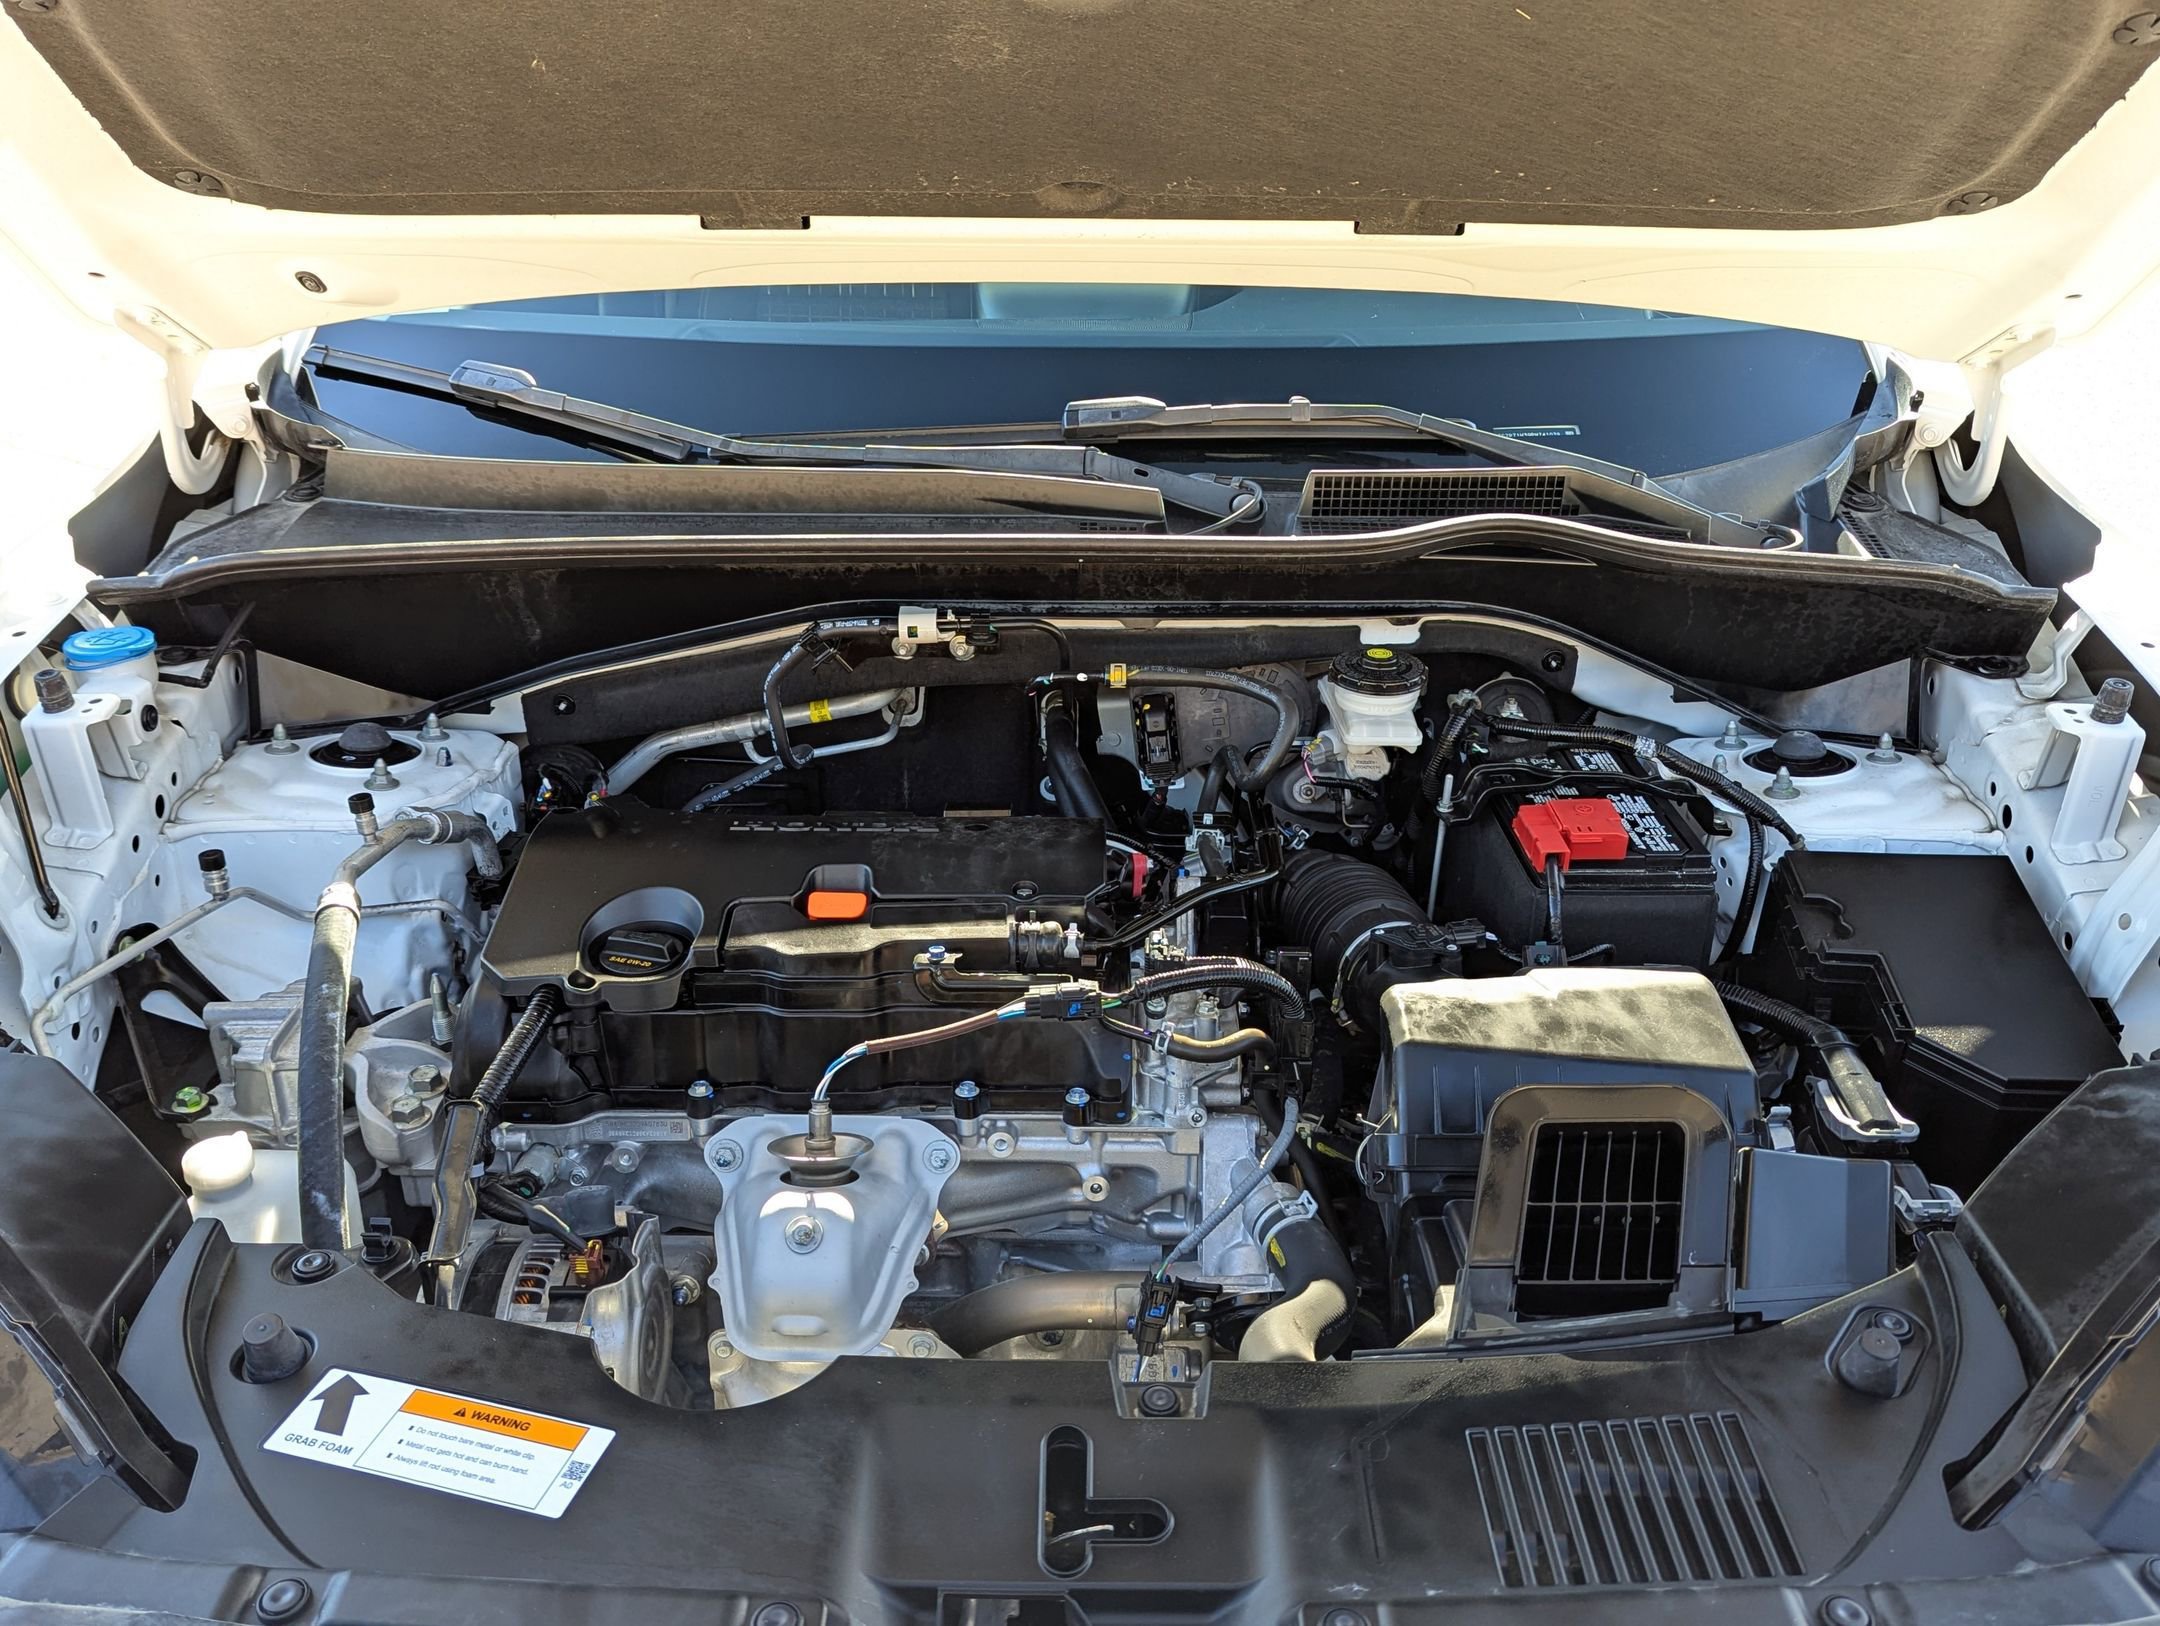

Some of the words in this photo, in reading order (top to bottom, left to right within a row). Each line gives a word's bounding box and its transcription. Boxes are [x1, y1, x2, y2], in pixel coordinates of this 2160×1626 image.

[608, 956, 627, 964] SAE
[471, 1409, 532, 1431] WARNING
[284, 1433, 318, 1448] GRAB
[317, 1440, 354, 1456] FOAM
[415, 1426, 427, 1435] Do
[426, 1430, 439, 1438] not
[438, 1432, 459, 1441] touch
[458, 1436, 475, 1446] bare
[474, 1441, 496, 1450] metal
[503, 1447, 522, 1457] white
[393, 1454, 419, 1465] Always
[418, 1460, 429, 1468] lift
[428, 1463, 442, 1471] rod
[440, 1466, 461, 1477] using
[460, 1469, 479, 1480] foam
[405, 1440, 426, 1450] Metal
[425, 1444, 438, 1453] rod
[436, 1448, 453, 1457] gets
[452, 1451, 465, 1460] hot
[464, 1455, 480, 1463] and
[478, 1459, 493, 1467] can
[492, 1461, 510, 1470] burn
